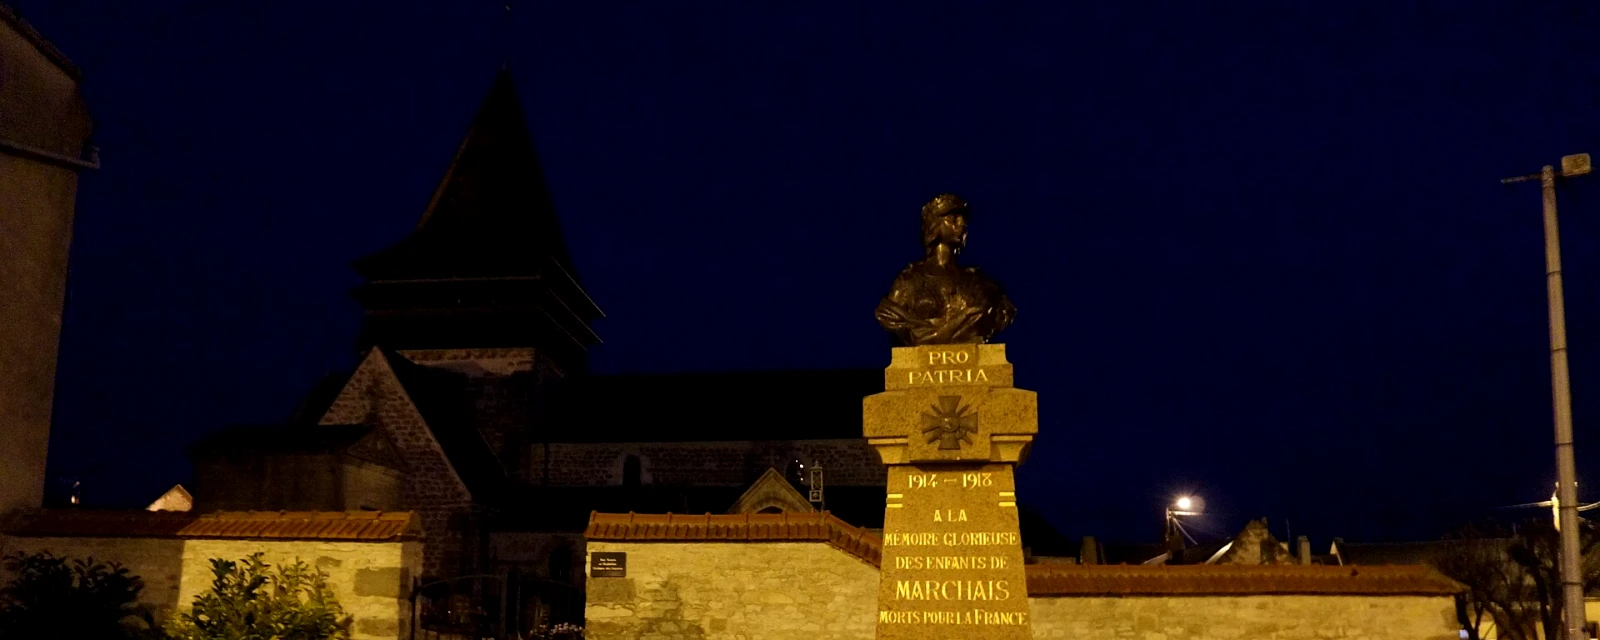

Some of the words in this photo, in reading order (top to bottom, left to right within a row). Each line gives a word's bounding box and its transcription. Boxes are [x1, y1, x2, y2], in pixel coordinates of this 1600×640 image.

[929, 351, 969, 365] PRO
[908, 368, 989, 385] PATRIA
[908, 474, 938, 489] 1914
[962, 473, 993, 490] 1918
[947, 509, 968, 522] LA
[884, 529, 941, 546] MÉMOIRE
[943, 532, 1018, 546] GLORIEUSE
[895, 556, 923, 570] DES
[926, 556, 987, 570] ENFANTS
[990, 556, 1009, 569] DE
[895, 580, 1010, 600] MARCHAIS
[879, 611, 921, 624] MORTS
[923, 611, 955, 625] POUR
[956, 611, 972, 625] LA
[974, 608, 1028, 625] FRANCE
